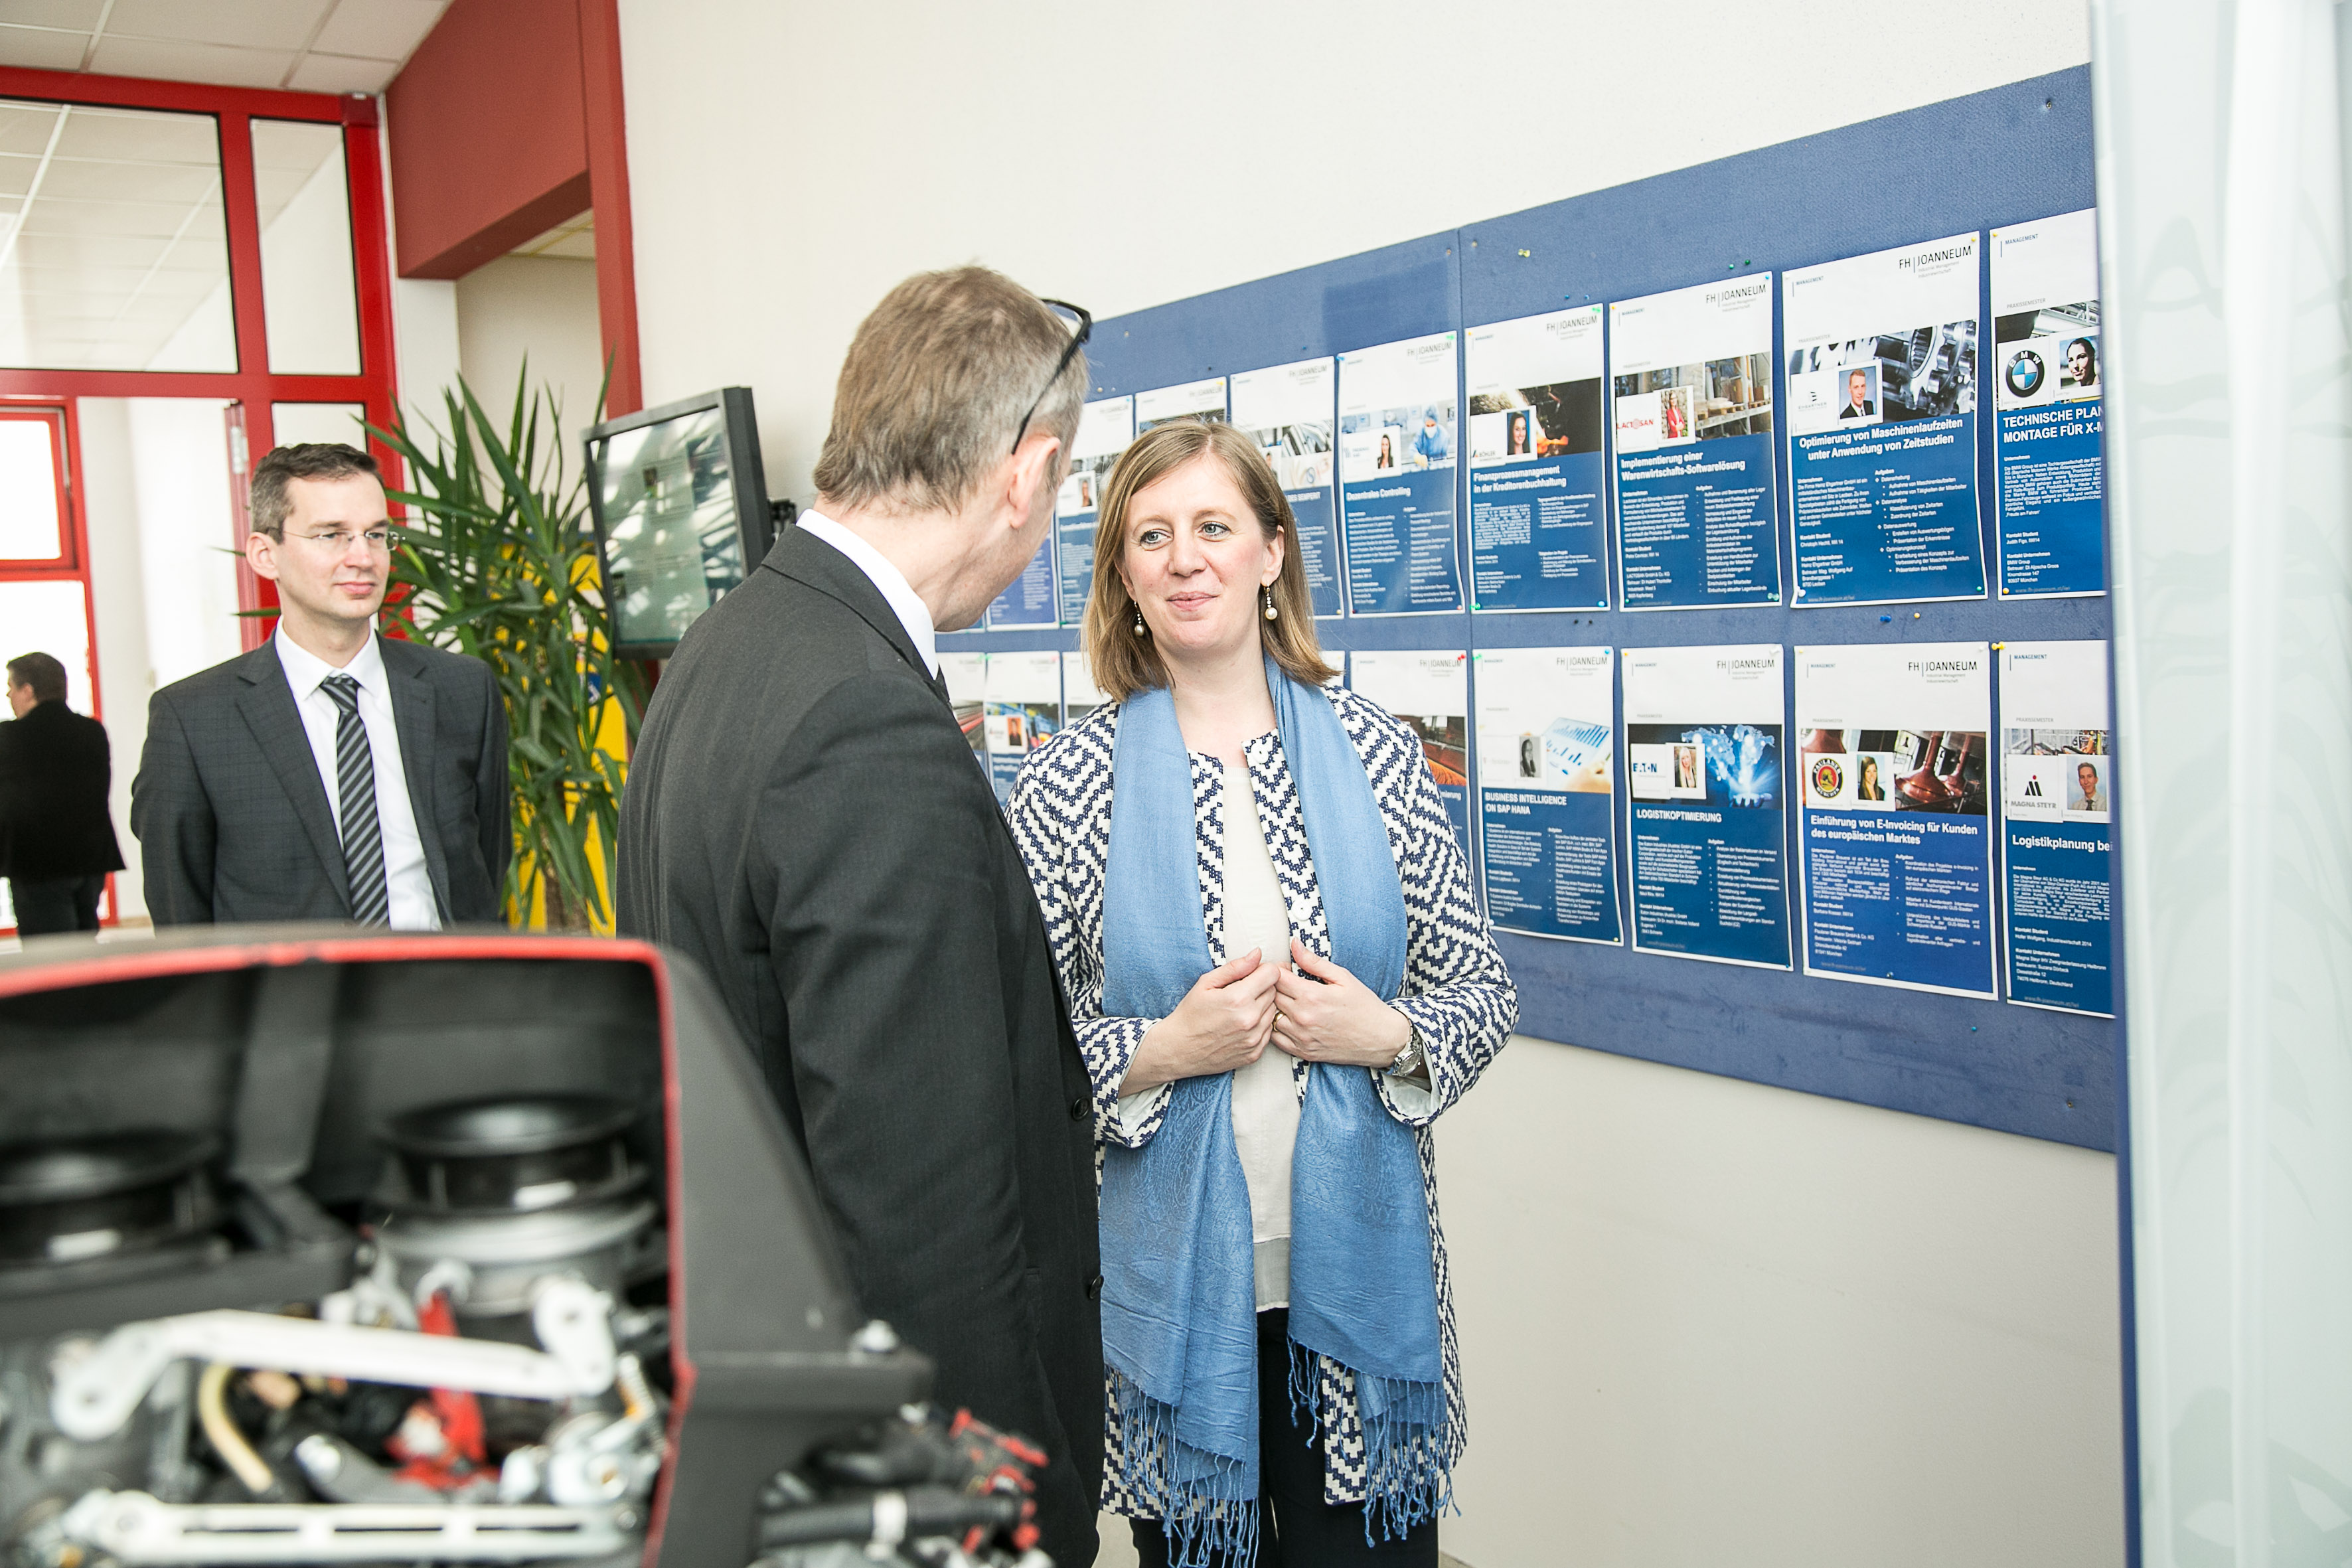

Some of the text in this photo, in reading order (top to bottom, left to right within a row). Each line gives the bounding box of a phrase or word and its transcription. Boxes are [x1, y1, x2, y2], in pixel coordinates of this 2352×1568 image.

[2005, 234, 2039, 244] MANAGEMENT
[1899, 246, 1972, 269] FH JOANNEUM
[1796, 275, 1824, 285] MANAGEMENT
[1706, 284, 1766, 303] FH JOANNEUM
[2007, 298, 2046, 309] PRAXISSEMESTER
[1559, 315, 1597, 329] JOANNEUM
[1419, 342, 1451, 354] JOANNEUM
[2008, 351, 2041, 368] BMW
[2003, 410, 2073, 428] TECHNISCHE
[1799, 418, 1962, 449] Optimierung von Maschinenlaufzeiten
[2003, 427, 2057, 443] MONTAGE
[2060, 422, 2083, 437] FÜR
[1808, 434, 1954, 461] unter Anwendung von Zeitstudien
[1621, 451, 1703, 469] Implementierung einer
[1474, 465, 1560, 482] Finanzprozessmanagement
[1622, 460, 1745, 481] Warenwirtschafts-Softwarelösung
[1482, 483, 1492, 492] der
[1493, 477, 1567, 491] Kreditorenbuchhaltung
[1346, 487, 1411, 501] Dezentrales Controlling
[1557, 657, 1607, 666] FH JOANNEUM
[1717, 659, 1774, 669] FH JOANNEUM
[1909, 661, 1977, 671] FH JOANNEUM
[1813, 759, 1842, 774] PAULANER
[1485, 792, 1567, 806] BUSINESS INTELLIGENCE
[1486, 804, 1531, 815] ON SAP HANA
[1636, 809, 1722, 823] LOGISTIKOPTIMIERUNG
[1810, 815, 1978, 834] Einführung von E-Invoicing für Kunden
[1811, 828, 1921, 844] des europäischen Marktes
[2012, 834, 2094, 853] Logistikplanung
